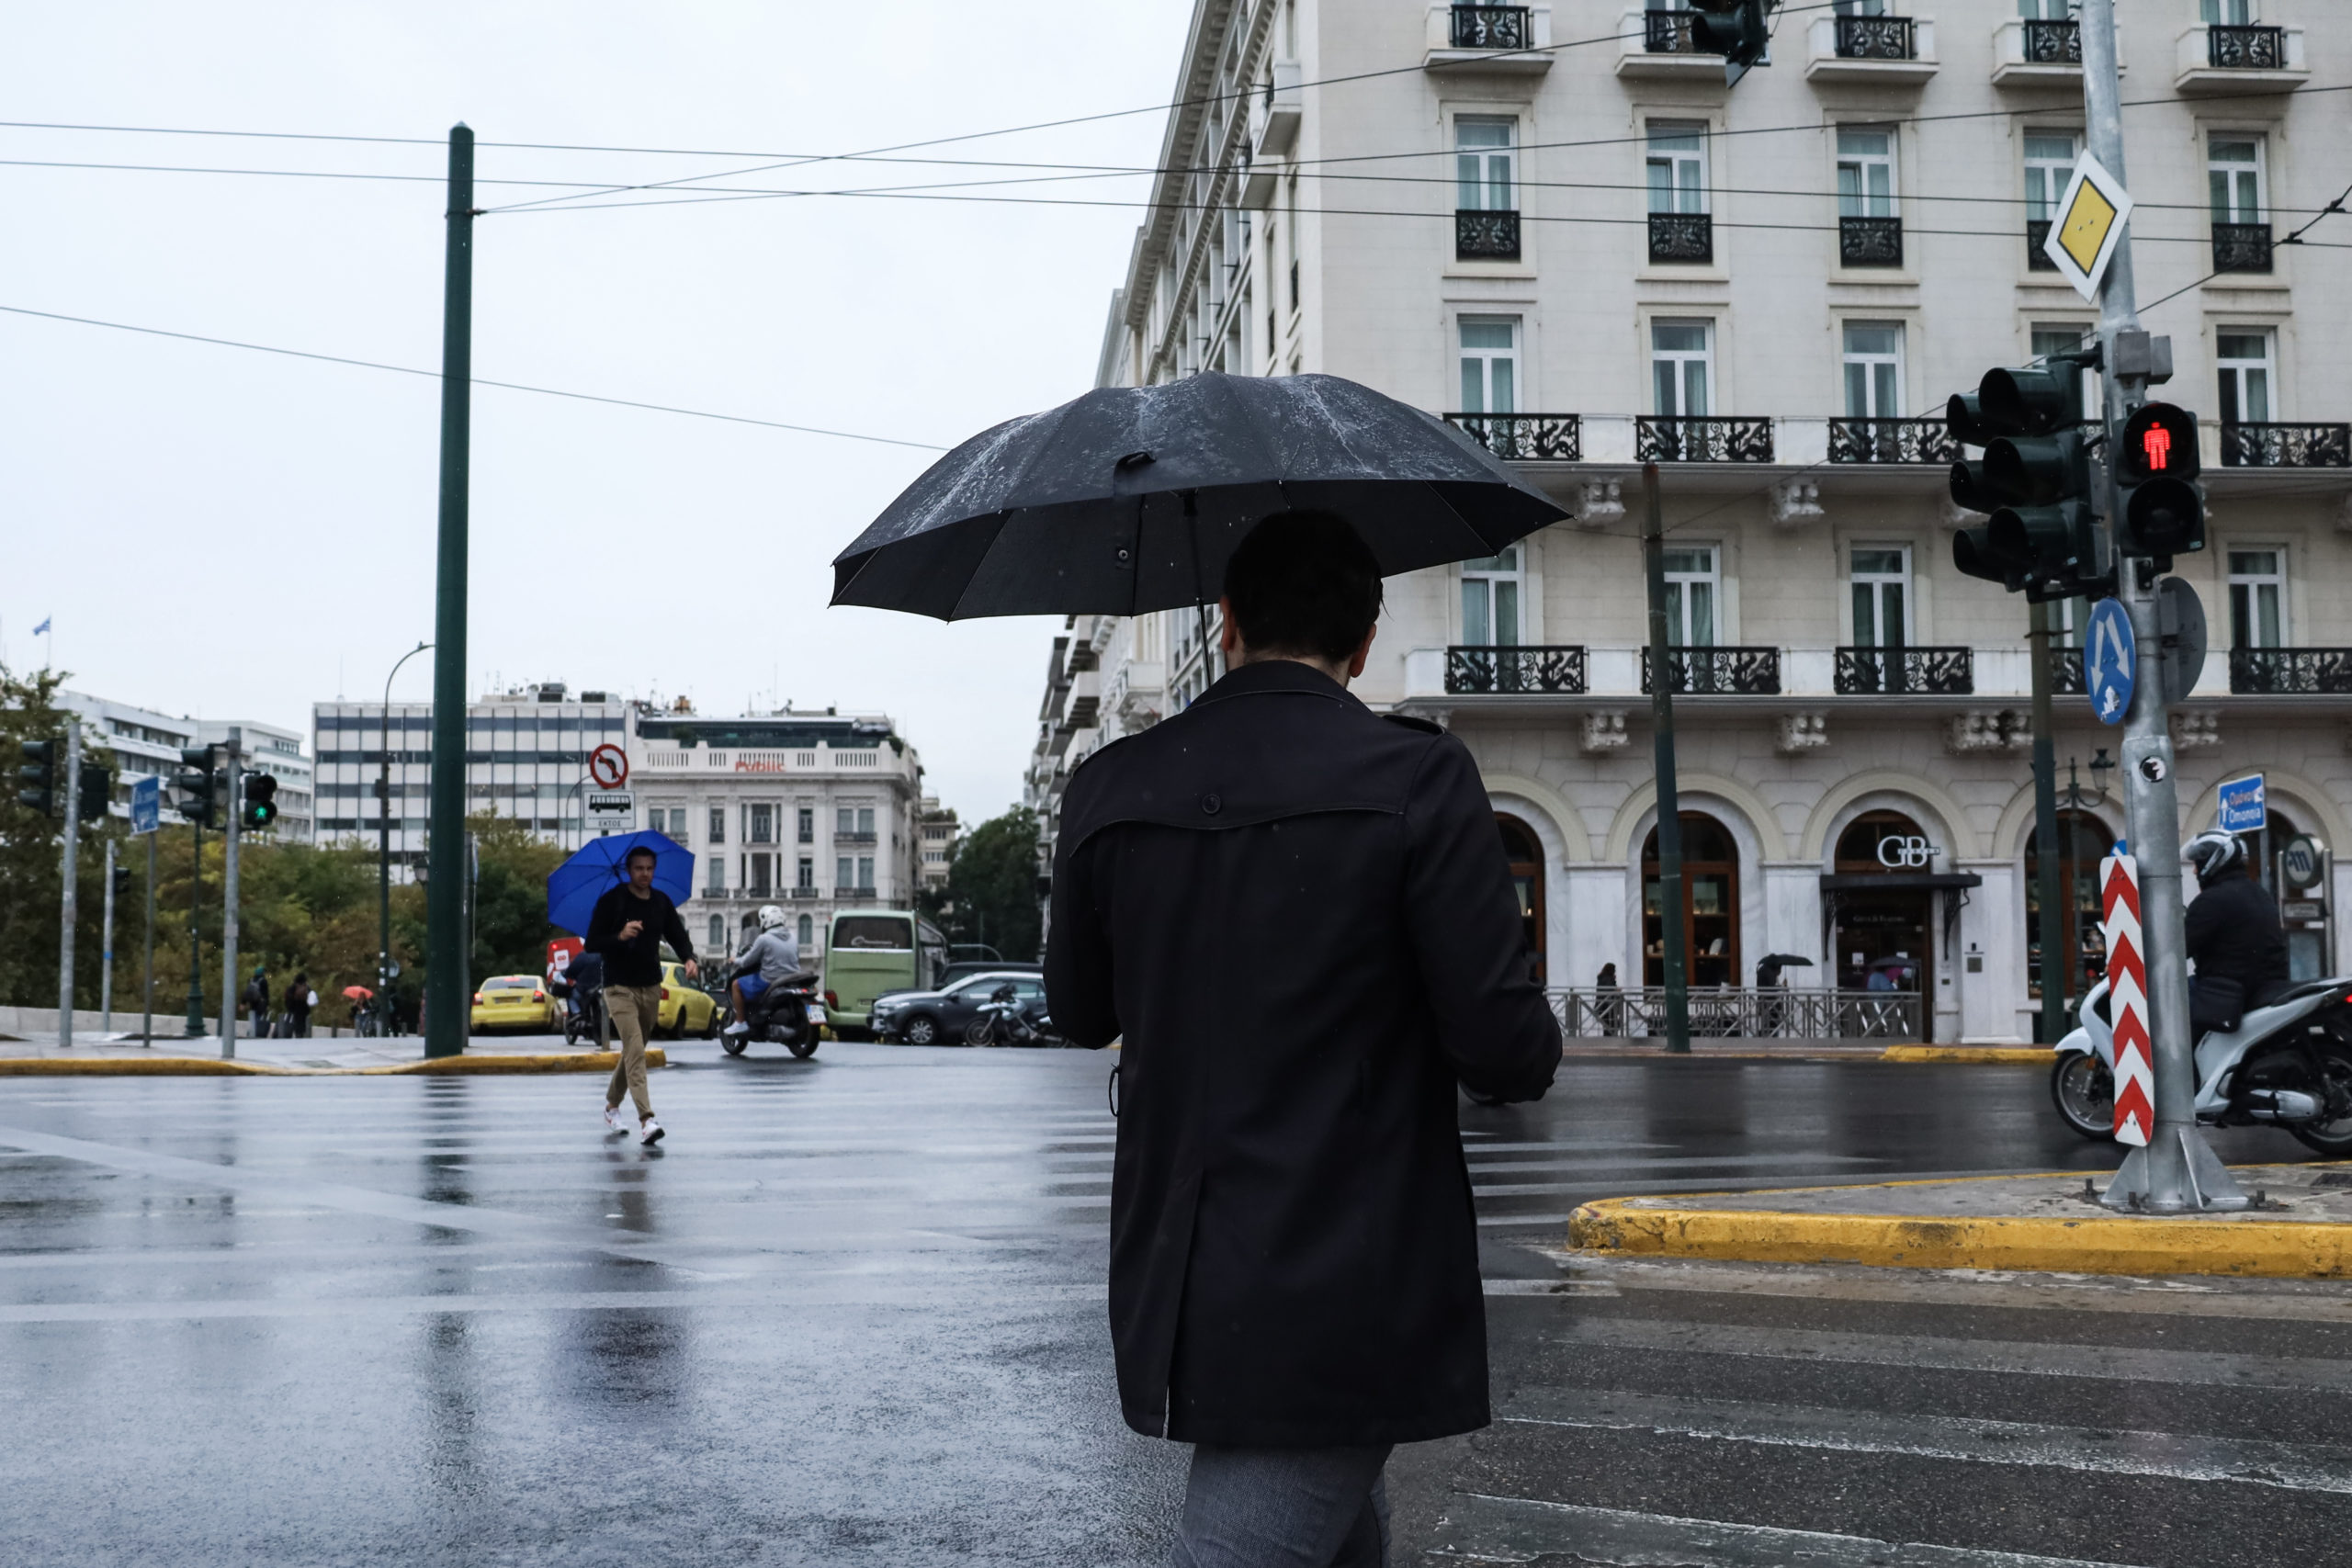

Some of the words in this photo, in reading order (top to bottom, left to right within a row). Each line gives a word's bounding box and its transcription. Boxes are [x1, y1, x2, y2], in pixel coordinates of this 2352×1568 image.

[735, 761, 785, 773] Public
[2229, 808, 2261, 824] Omonoia
[1877, 835, 1928, 867] GB
